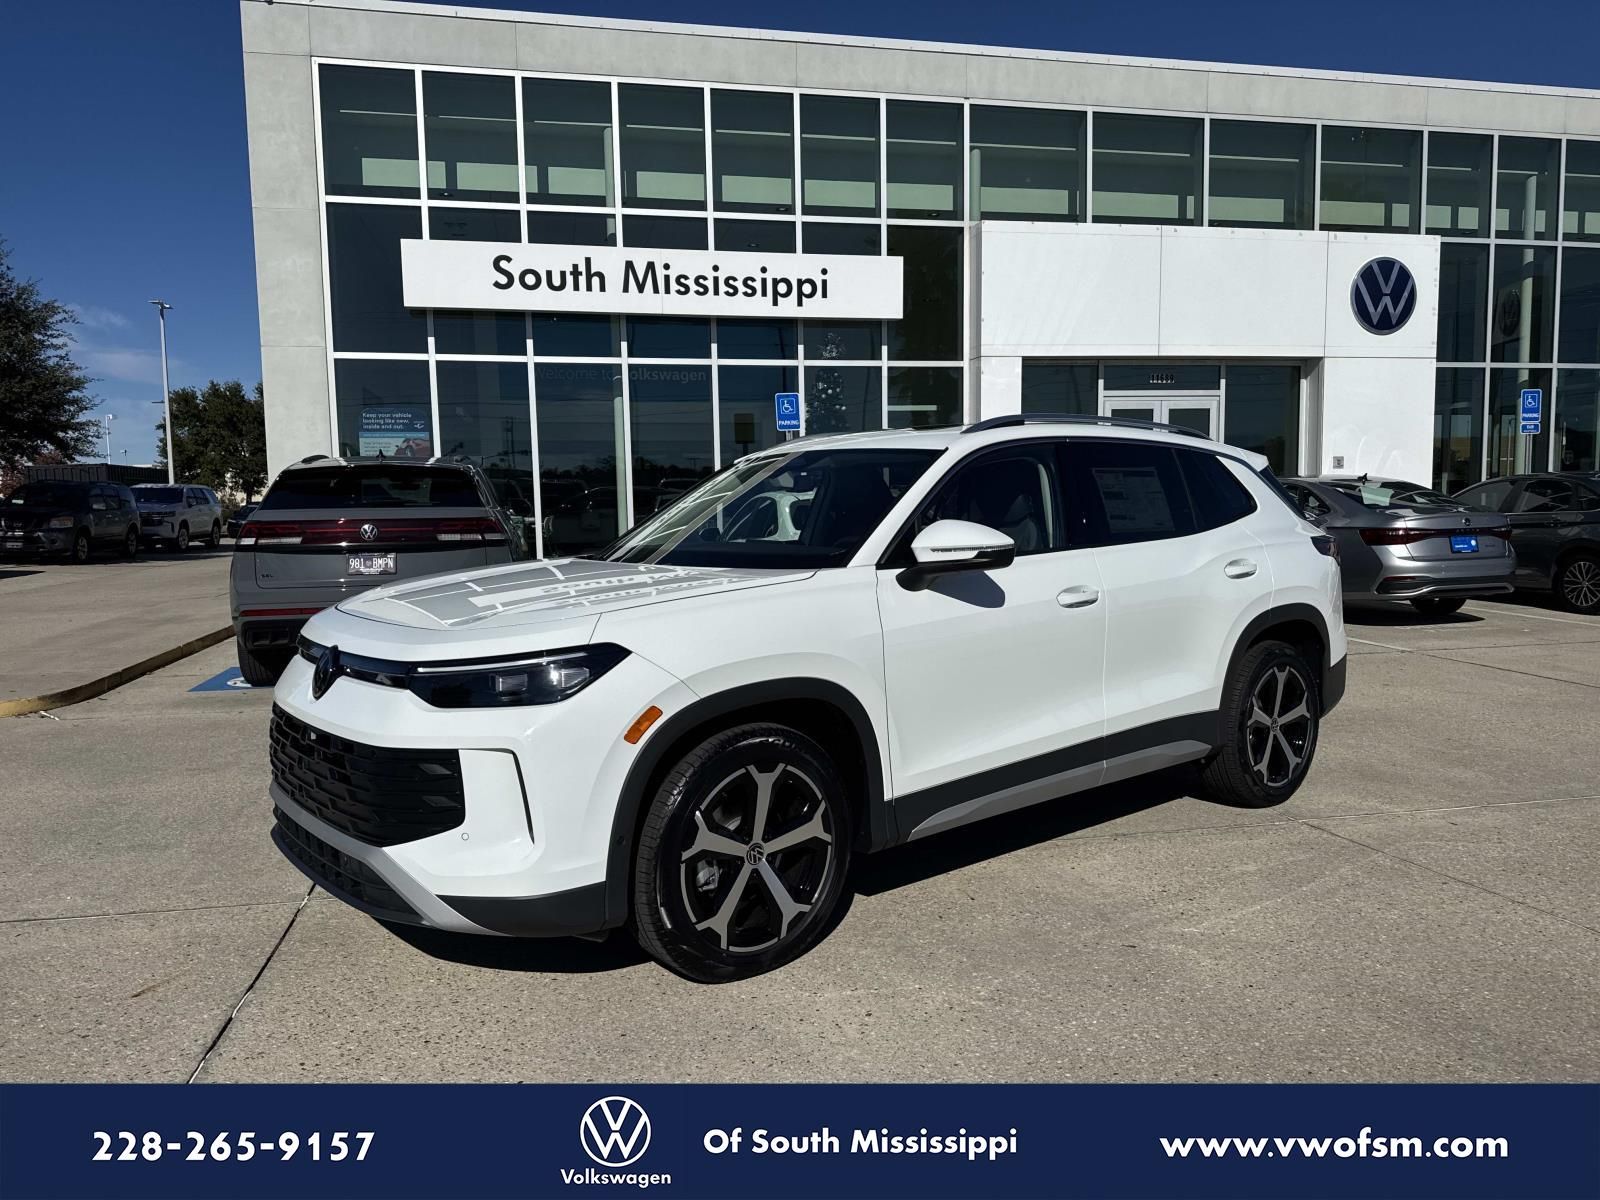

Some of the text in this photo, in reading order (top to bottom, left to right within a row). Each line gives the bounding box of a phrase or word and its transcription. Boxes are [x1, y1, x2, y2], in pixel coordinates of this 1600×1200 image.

[492, 254, 829, 307] South Mississippi
[630, 367, 706, 384] olkswagen
[349, 557, 394, 569] 981 BMPN
